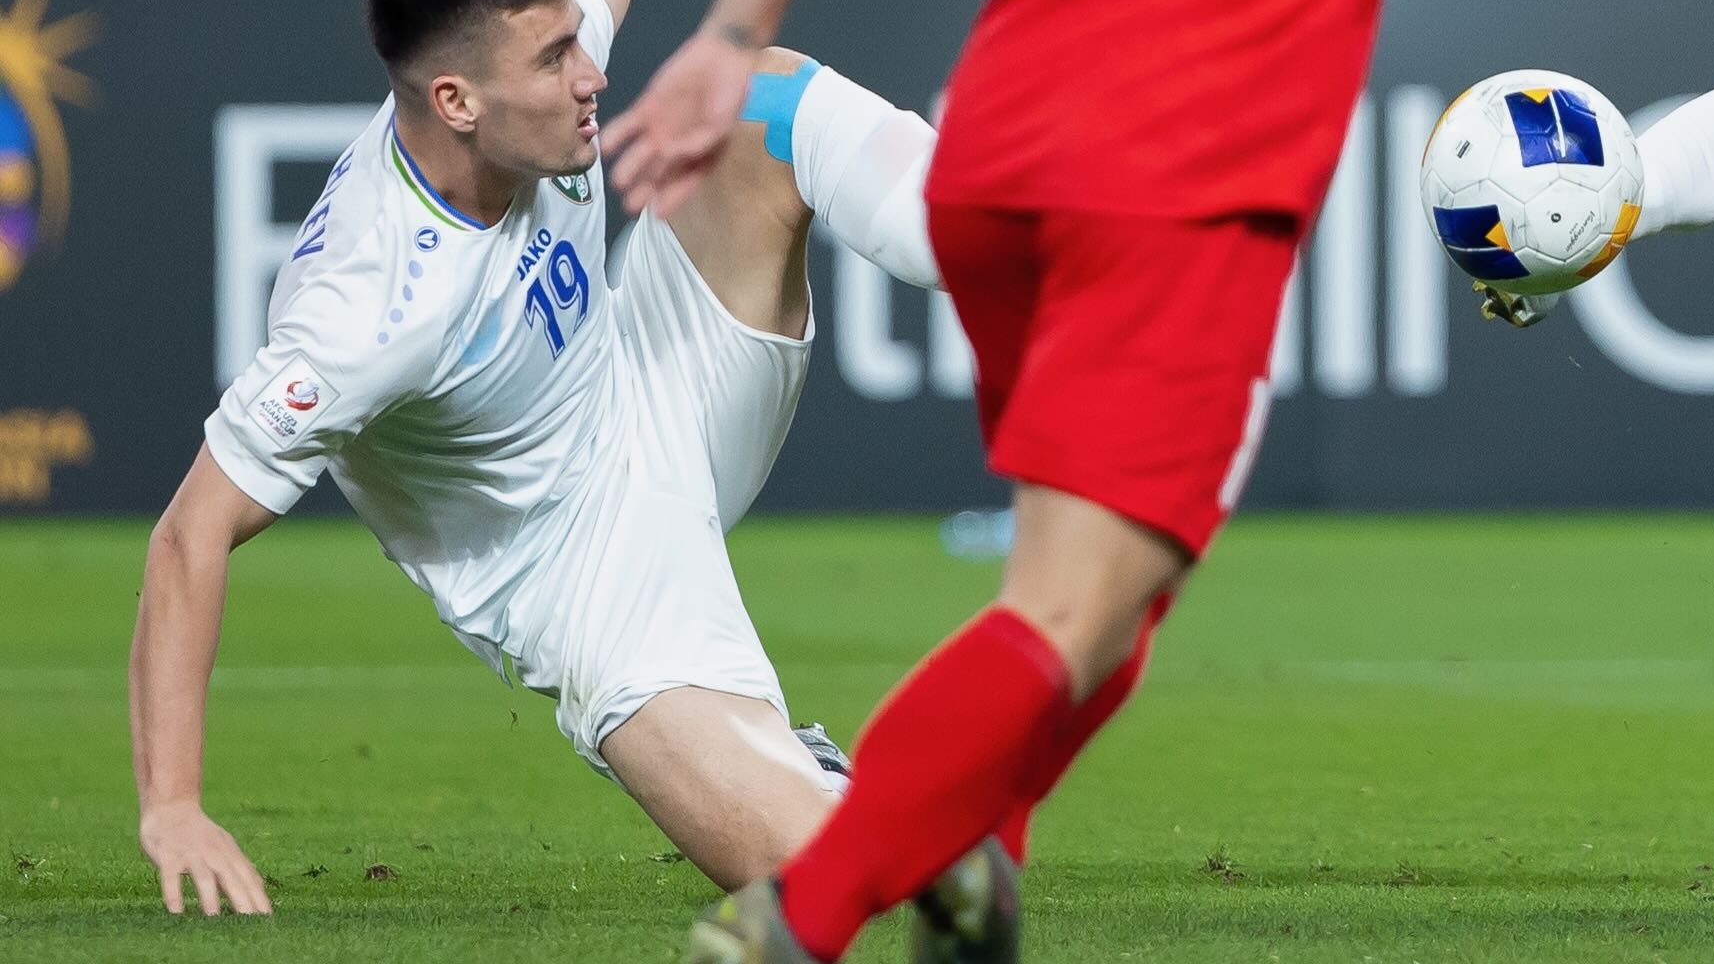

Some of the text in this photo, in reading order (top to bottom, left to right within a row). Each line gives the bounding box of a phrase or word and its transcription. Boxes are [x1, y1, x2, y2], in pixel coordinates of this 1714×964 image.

[517, 228, 552, 281] JAKO
[524, 240, 590, 361] 19
[259, 400, 297, 436] ASIAN CUP
[269, 398, 284, 414] AFC
